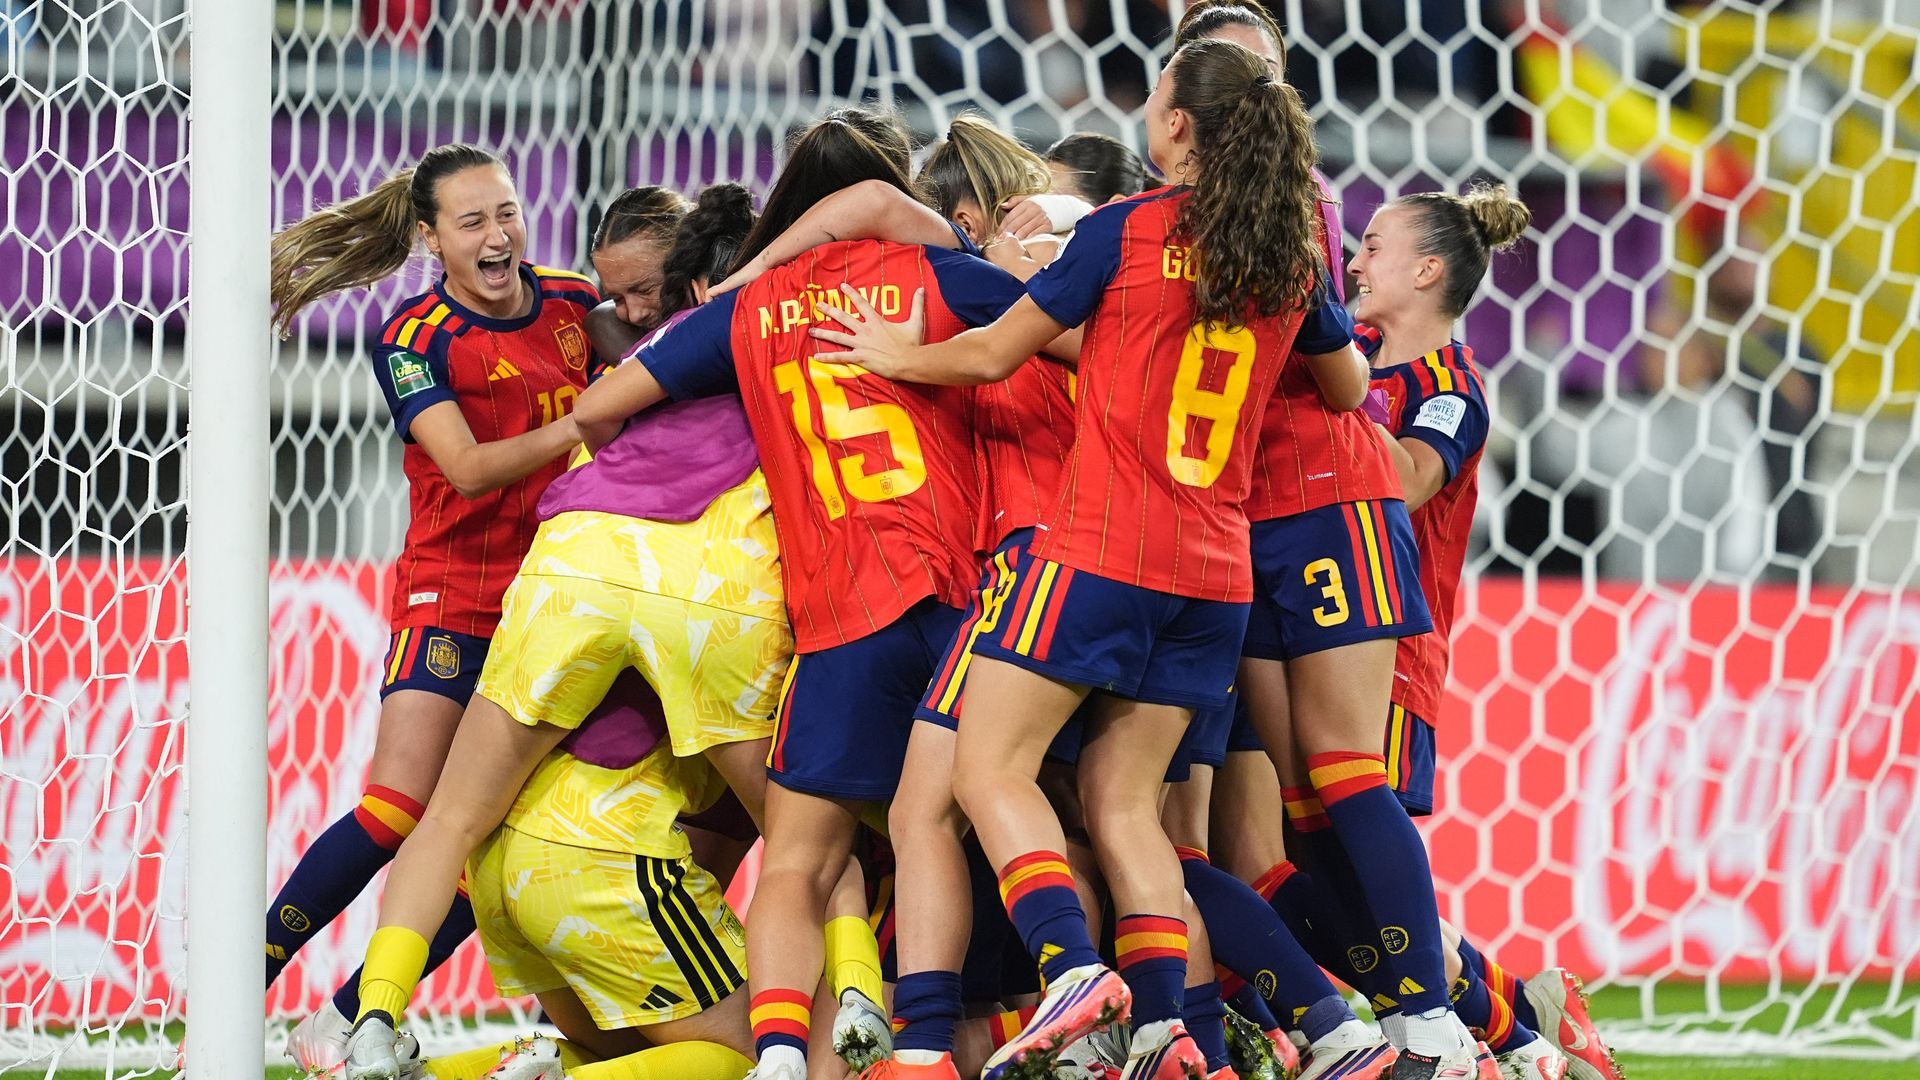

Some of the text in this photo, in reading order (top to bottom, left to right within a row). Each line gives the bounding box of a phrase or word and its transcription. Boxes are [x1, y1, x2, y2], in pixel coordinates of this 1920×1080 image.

[773, 357, 927, 521] 15
[1166, 319, 1257, 489] 8
[1428, 404, 1455, 418] UNITES
[1303, 557, 1350, 628] 3
